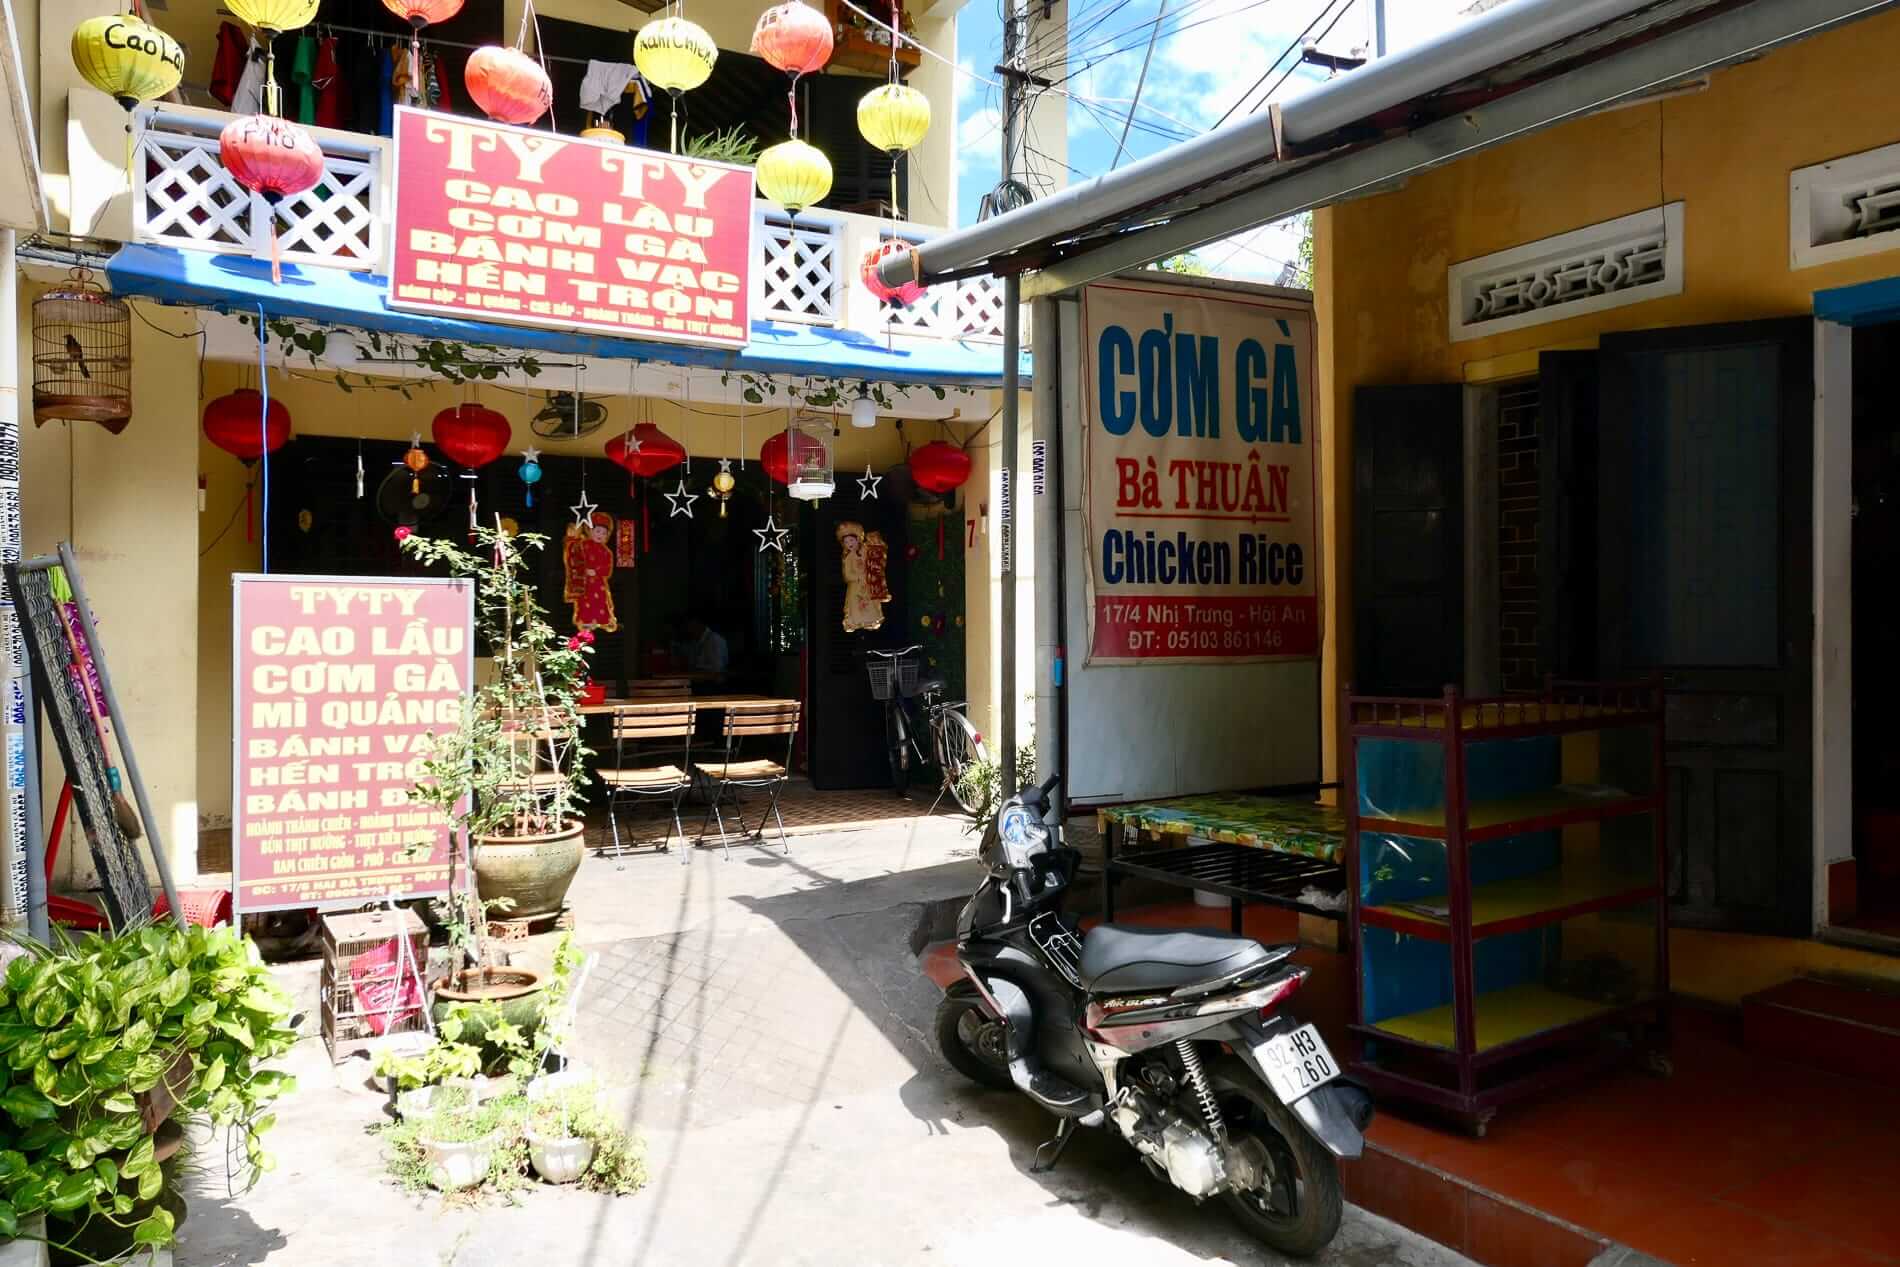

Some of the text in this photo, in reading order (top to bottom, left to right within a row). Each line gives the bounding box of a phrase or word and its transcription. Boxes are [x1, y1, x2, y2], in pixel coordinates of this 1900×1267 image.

[104, 23, 157, 55] Cao
[445, 179, 579, 217] CAO
[448, 208, 708, 264] CƠM GÀ
[410, 229, 740, 293] BÁNH VẠC
[416, 259, 733, 320] HẾN TRỘN
[1099, 312, 1302, 444] CƠM GÀ
[1115, 456, 1162, 508] Bà
[1103, 529, 1304, 585] Chicken Rice
[1103, 605, 1141, 624] 17/4
[1147, 605, 1180, 627] Nhị
[1184, 605, 1233, 628] Trưng
[1282, 606, 1306, 624] An
[251, 626, 355, 656] CAO
[1128, 630, 1161, 650] ĐT:
[1167, 631, 1218, 649] 05103
[252, 658, 460, 694] CƠM GÀ
[252, 696, 307, 729] MÌ
[249, 734, 371, 759] BÁNH
[249, 759, 340, 787] HẾN
[246, 789, 369, 815] BÁNH
